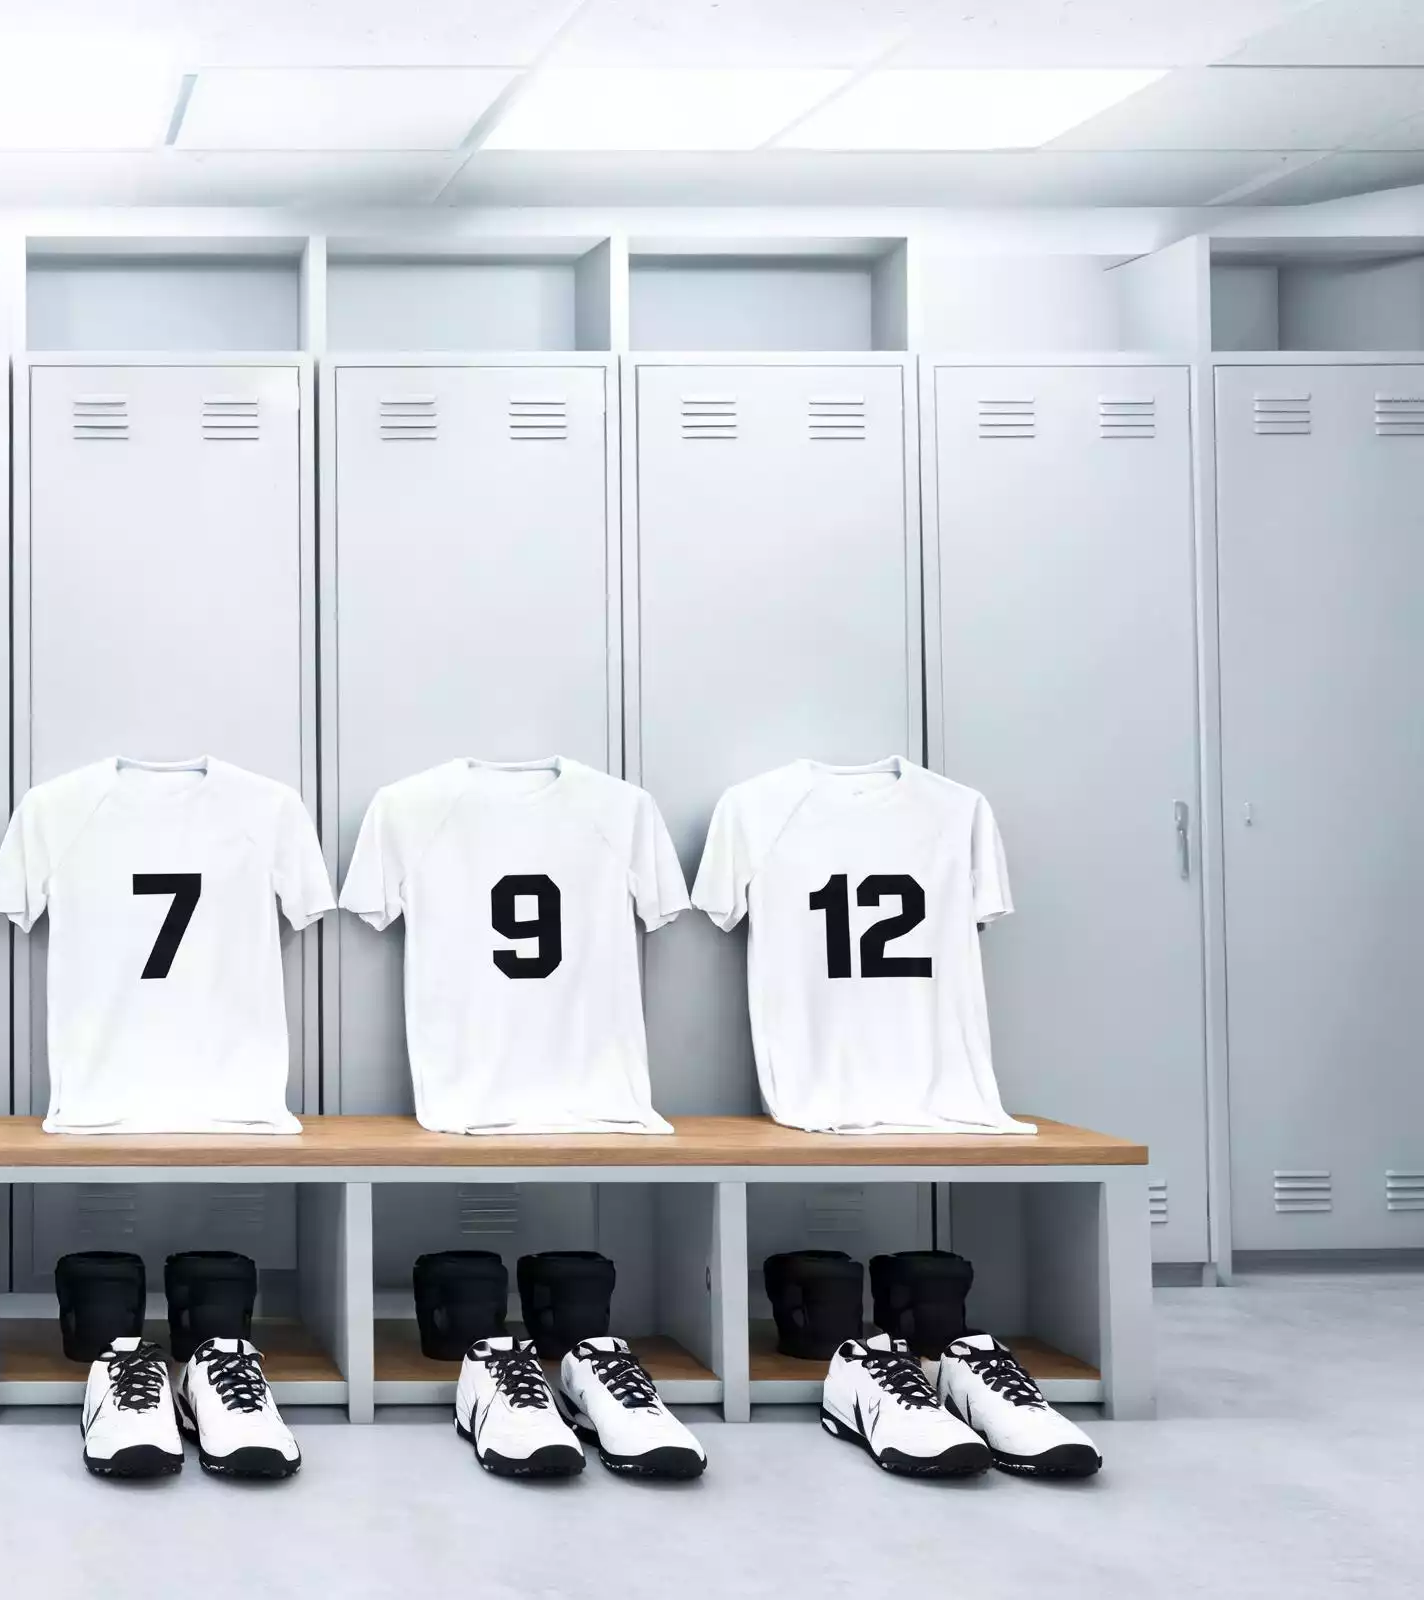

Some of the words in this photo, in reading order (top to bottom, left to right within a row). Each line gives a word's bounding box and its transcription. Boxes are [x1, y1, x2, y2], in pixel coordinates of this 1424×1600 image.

[132, 872, 202, 980] 7
[490, 873, 563, 980] 9
[809, 873, 933, 979] 12
